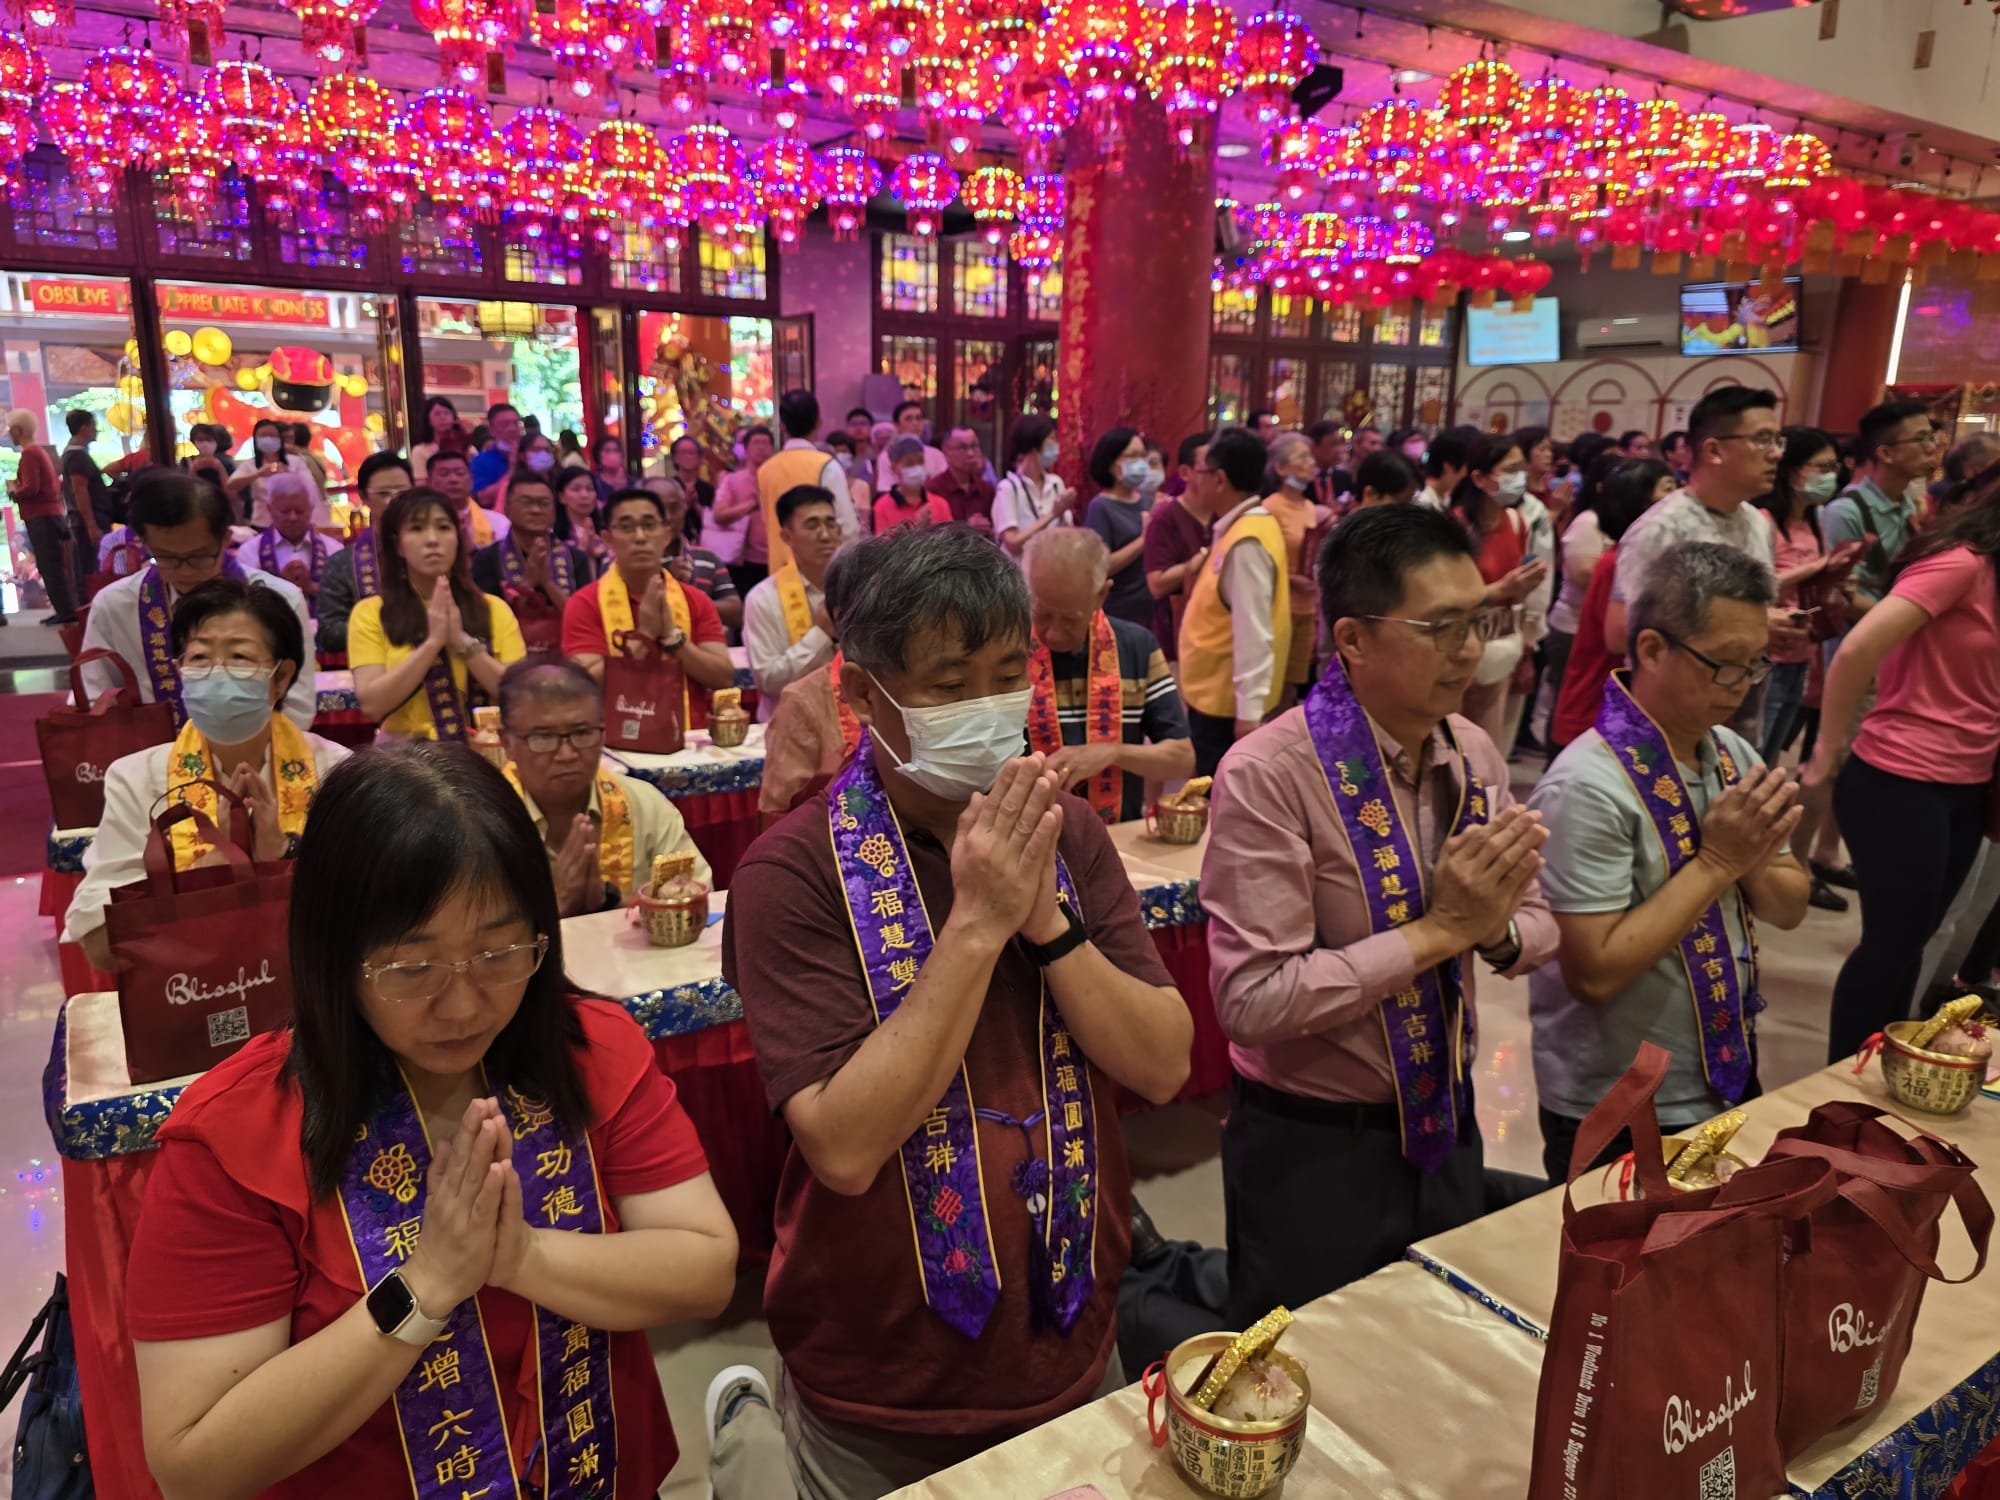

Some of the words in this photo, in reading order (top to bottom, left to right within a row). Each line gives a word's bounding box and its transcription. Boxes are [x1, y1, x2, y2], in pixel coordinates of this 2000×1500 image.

[253, 298, 325, 319] KNDNSS
[870, 887, 919, 991] 福慧雙
[165, 959, 276, 1005] Blissful
[536, 1140, 585, 1226] 功德
[1590, 1312, 1609, 1328] No
[1579, 1343, 1603, 1391] Woodlands
[559, 1323, 600, 1488] 萬福圓滿
[1573, 1392, 1594, 1418] Drive
[1663, 1359, 1757, 1455] Blissful
[1569, 1421, 1588, 1438] 16
